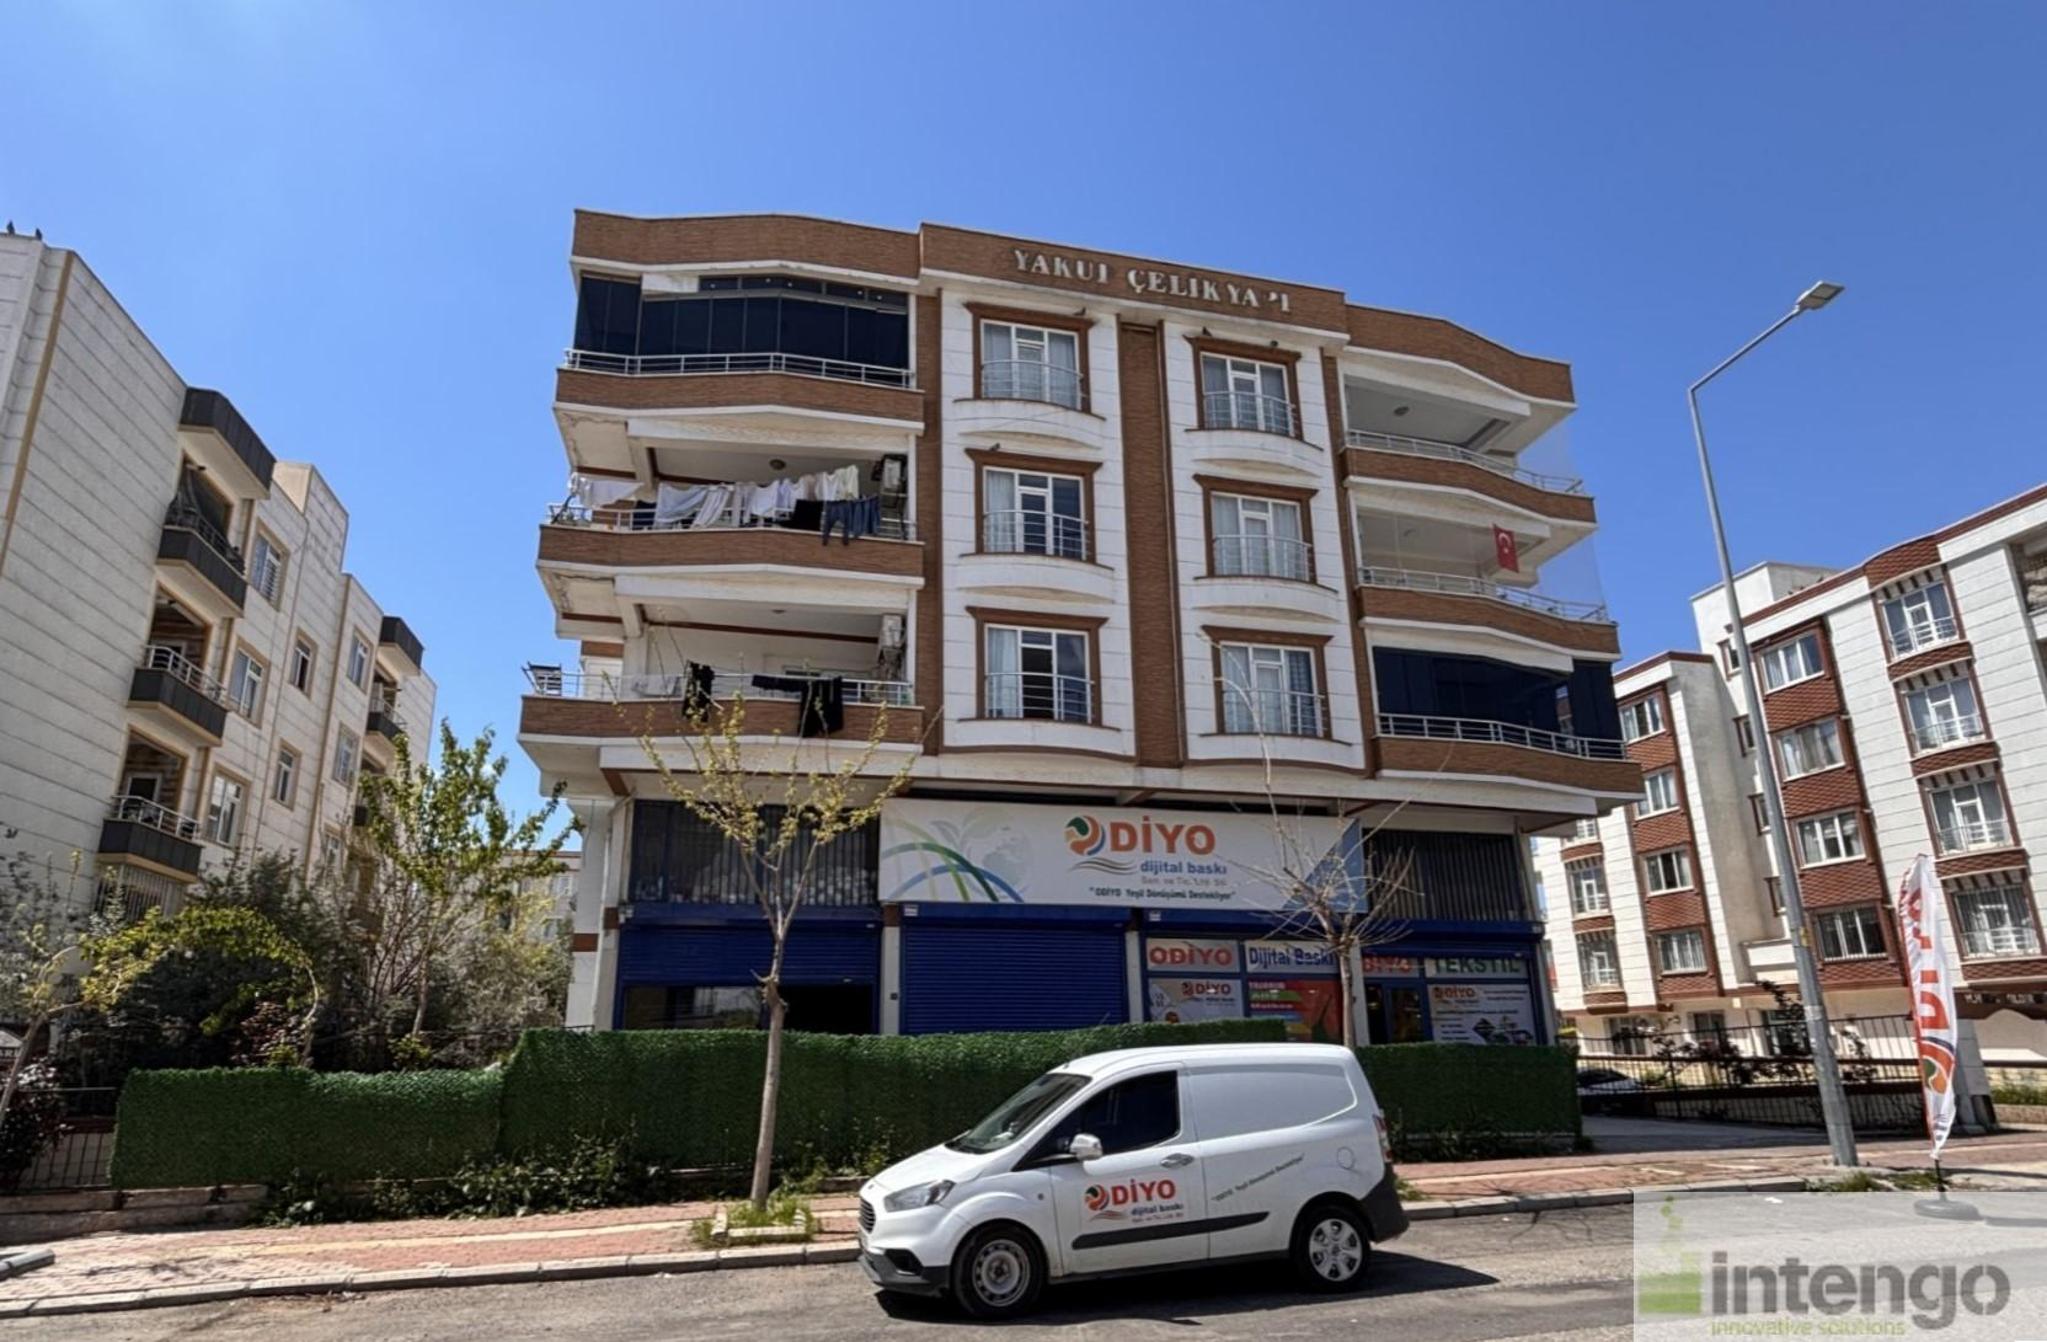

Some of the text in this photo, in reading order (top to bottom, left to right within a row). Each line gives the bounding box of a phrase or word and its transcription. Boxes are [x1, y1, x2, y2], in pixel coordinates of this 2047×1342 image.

[1140, 860, 1228, 875] dijital baskı
[1249, 947, 1290, 969] Dijital
